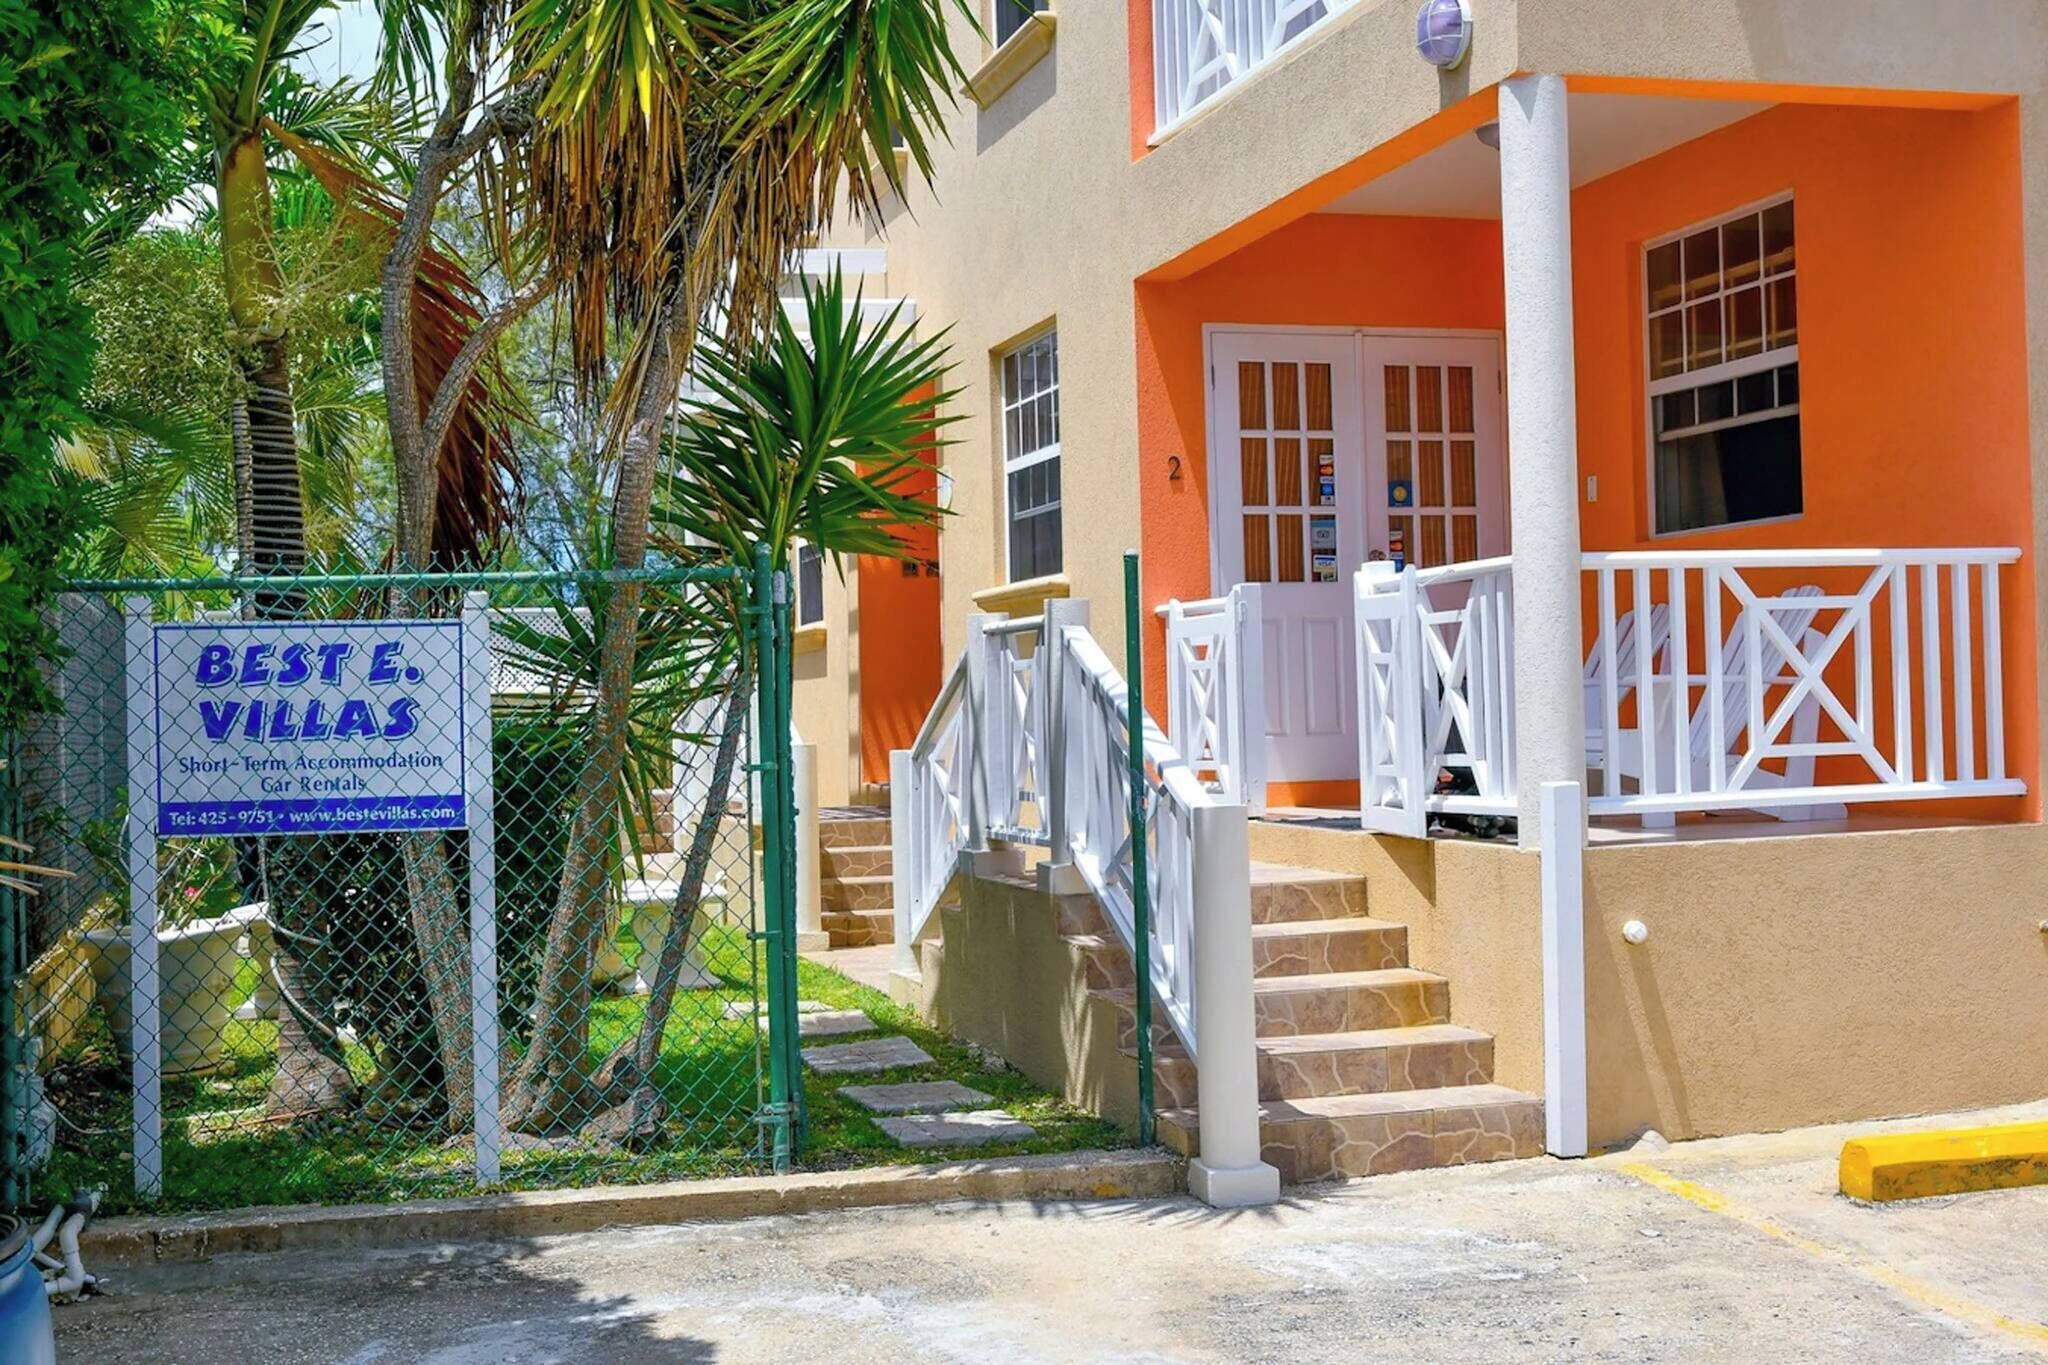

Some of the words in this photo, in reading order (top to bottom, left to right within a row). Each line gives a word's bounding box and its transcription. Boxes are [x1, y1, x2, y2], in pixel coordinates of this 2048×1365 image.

[1168, 456, 1181, 481] 2
[195, 642, 352, 689] BEST
[367, 642, 425, 687] E.
[199, 699, 421, 744] VILLAS
[179, 756, 287, 773] Short-Term
[295, 751, 443, 771] Accommodation
[261, 776, 292, 793] Car
[301, 774, 366, 792] Rentals
[198, 810, 275, 824] 425-9751
[288, 805, 456, 823] www.bestevillas.com
